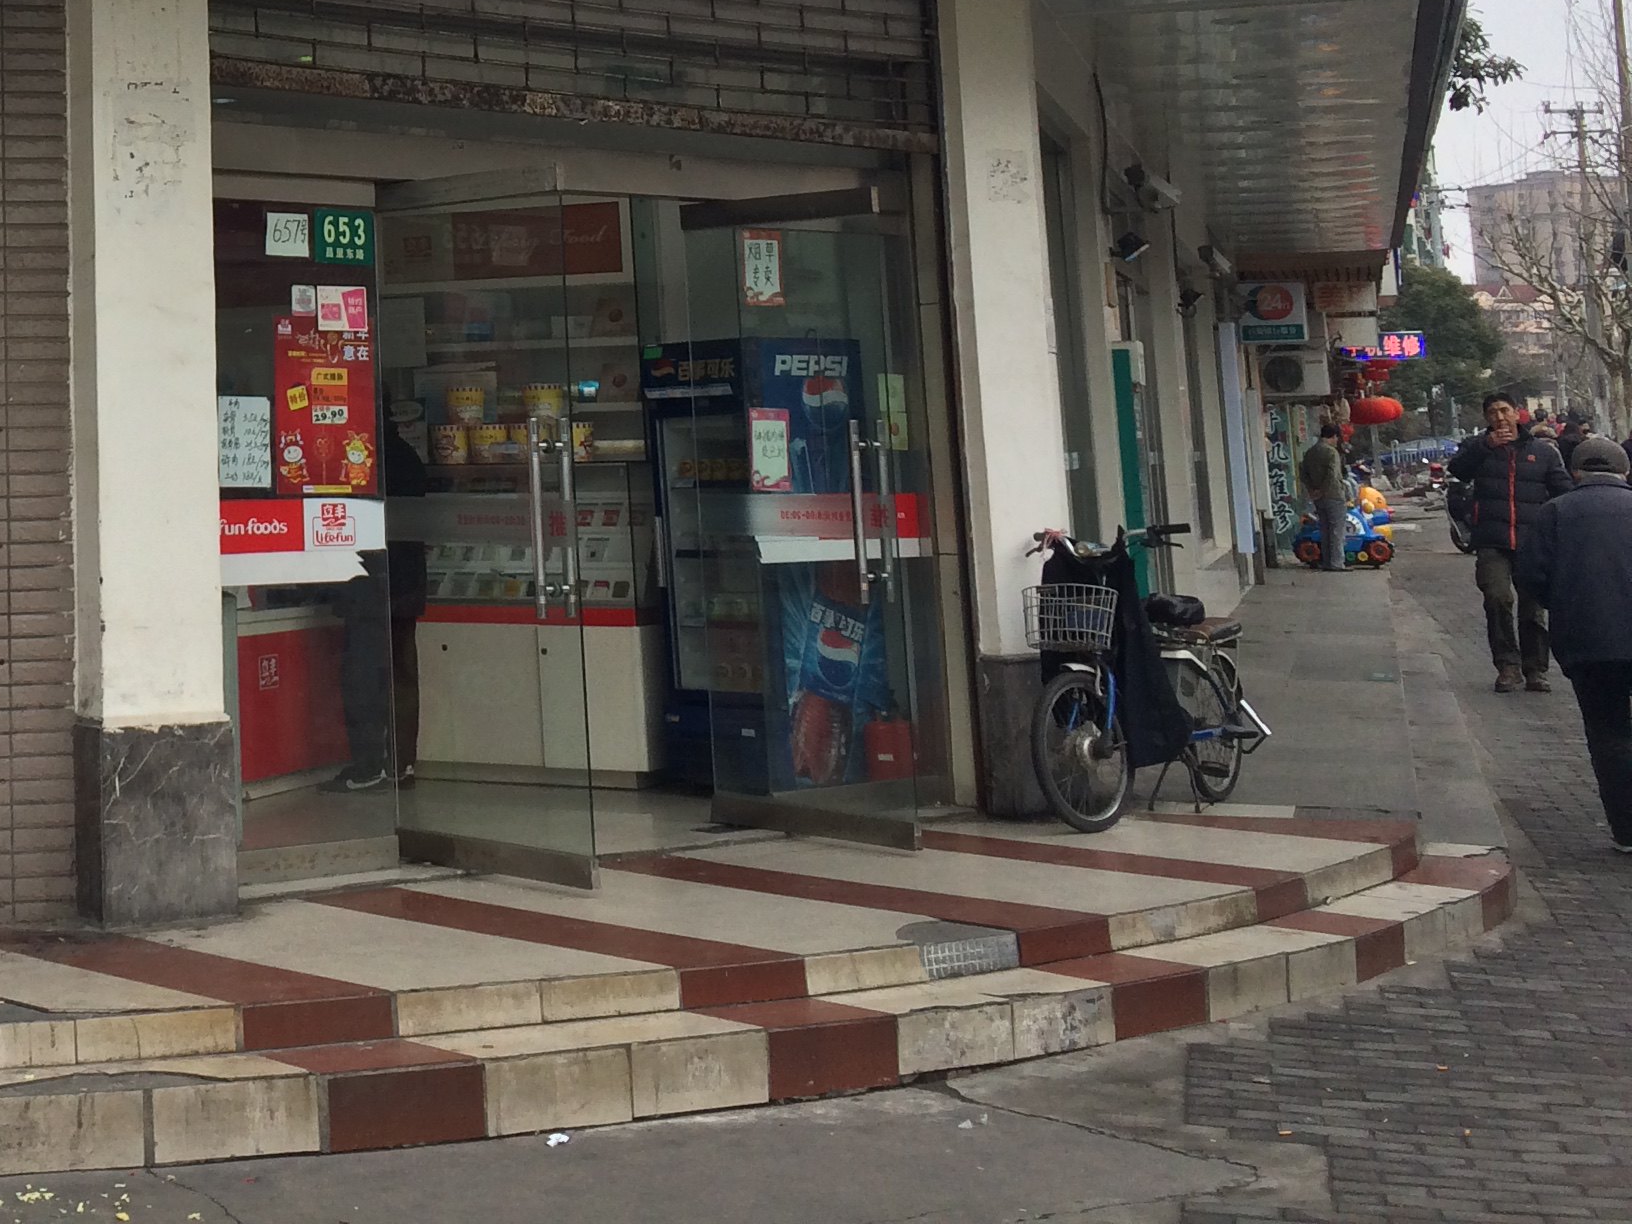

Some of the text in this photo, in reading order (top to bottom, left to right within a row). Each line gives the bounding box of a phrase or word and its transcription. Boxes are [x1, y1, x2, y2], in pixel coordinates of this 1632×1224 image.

[323, 215, 366, 246] 653
[774, 354, 849, 377] PEPSI
[322, 504, 346, 518] 立丰
[247, 517, 288, 535] foods
